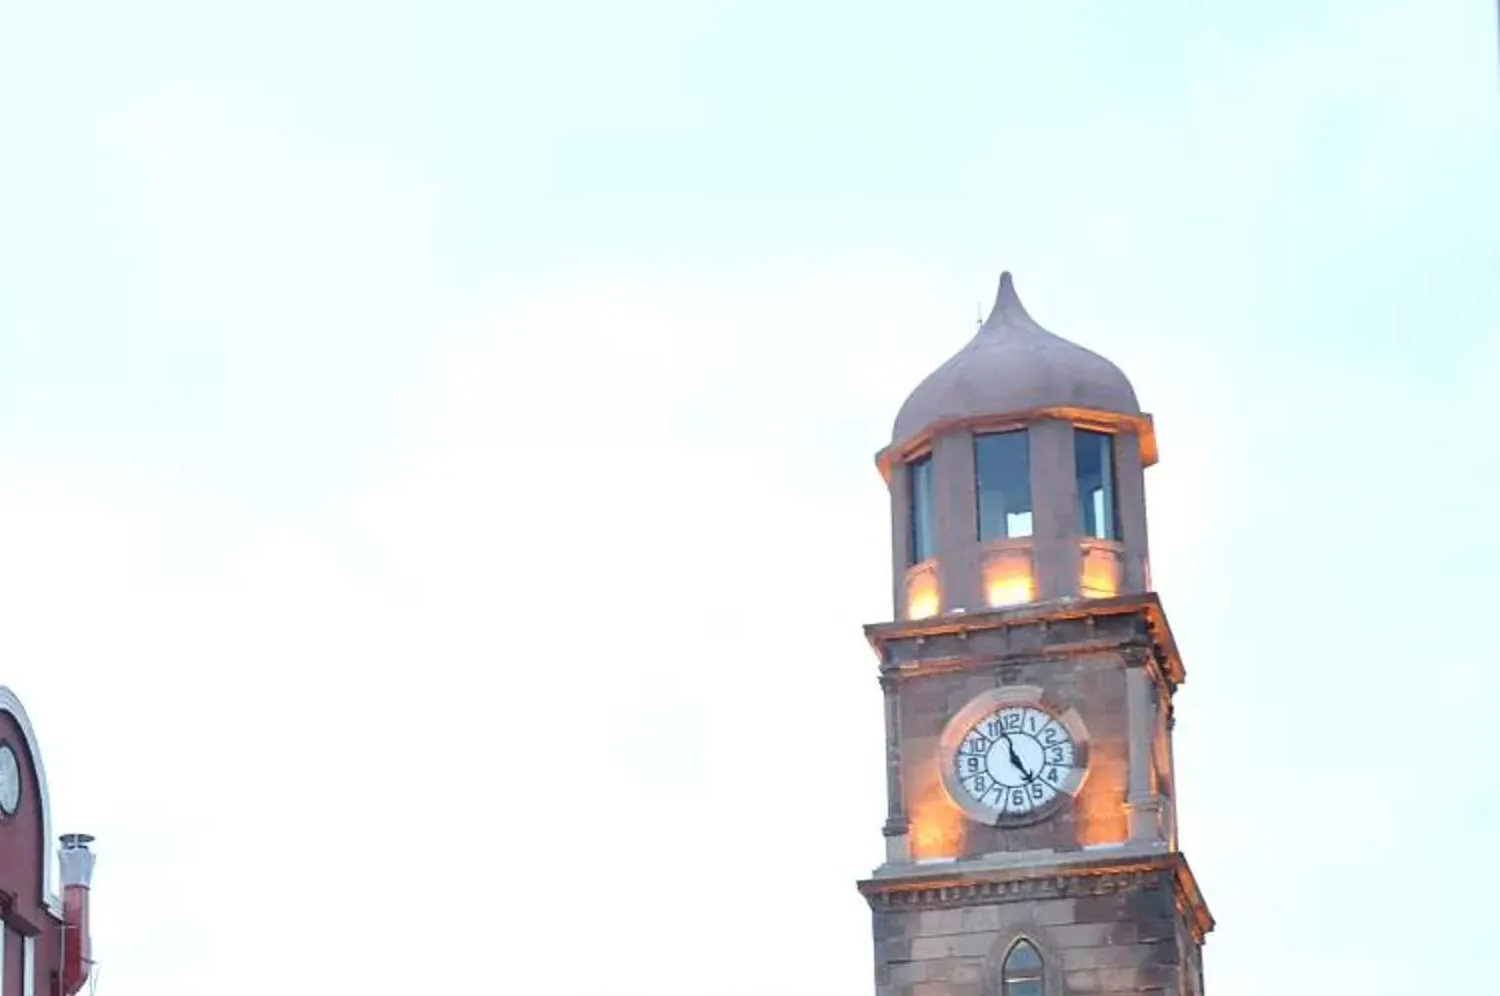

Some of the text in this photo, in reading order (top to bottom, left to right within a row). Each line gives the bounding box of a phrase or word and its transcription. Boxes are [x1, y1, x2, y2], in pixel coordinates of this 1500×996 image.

[1003, 713, 1021, 729] 12
[1044, 728, 1057, 744] 2
[1052, 747, 1064, 763] 3
[967, 757, 979, 772] 9
[1047, 767, 1058, 782] 4
[975, 776, 985, 791] 8
[1032, 783, 1043, 798] 5
[993, 787, 1004, 804] 7
[1012, 790, 1024, 805] 6
